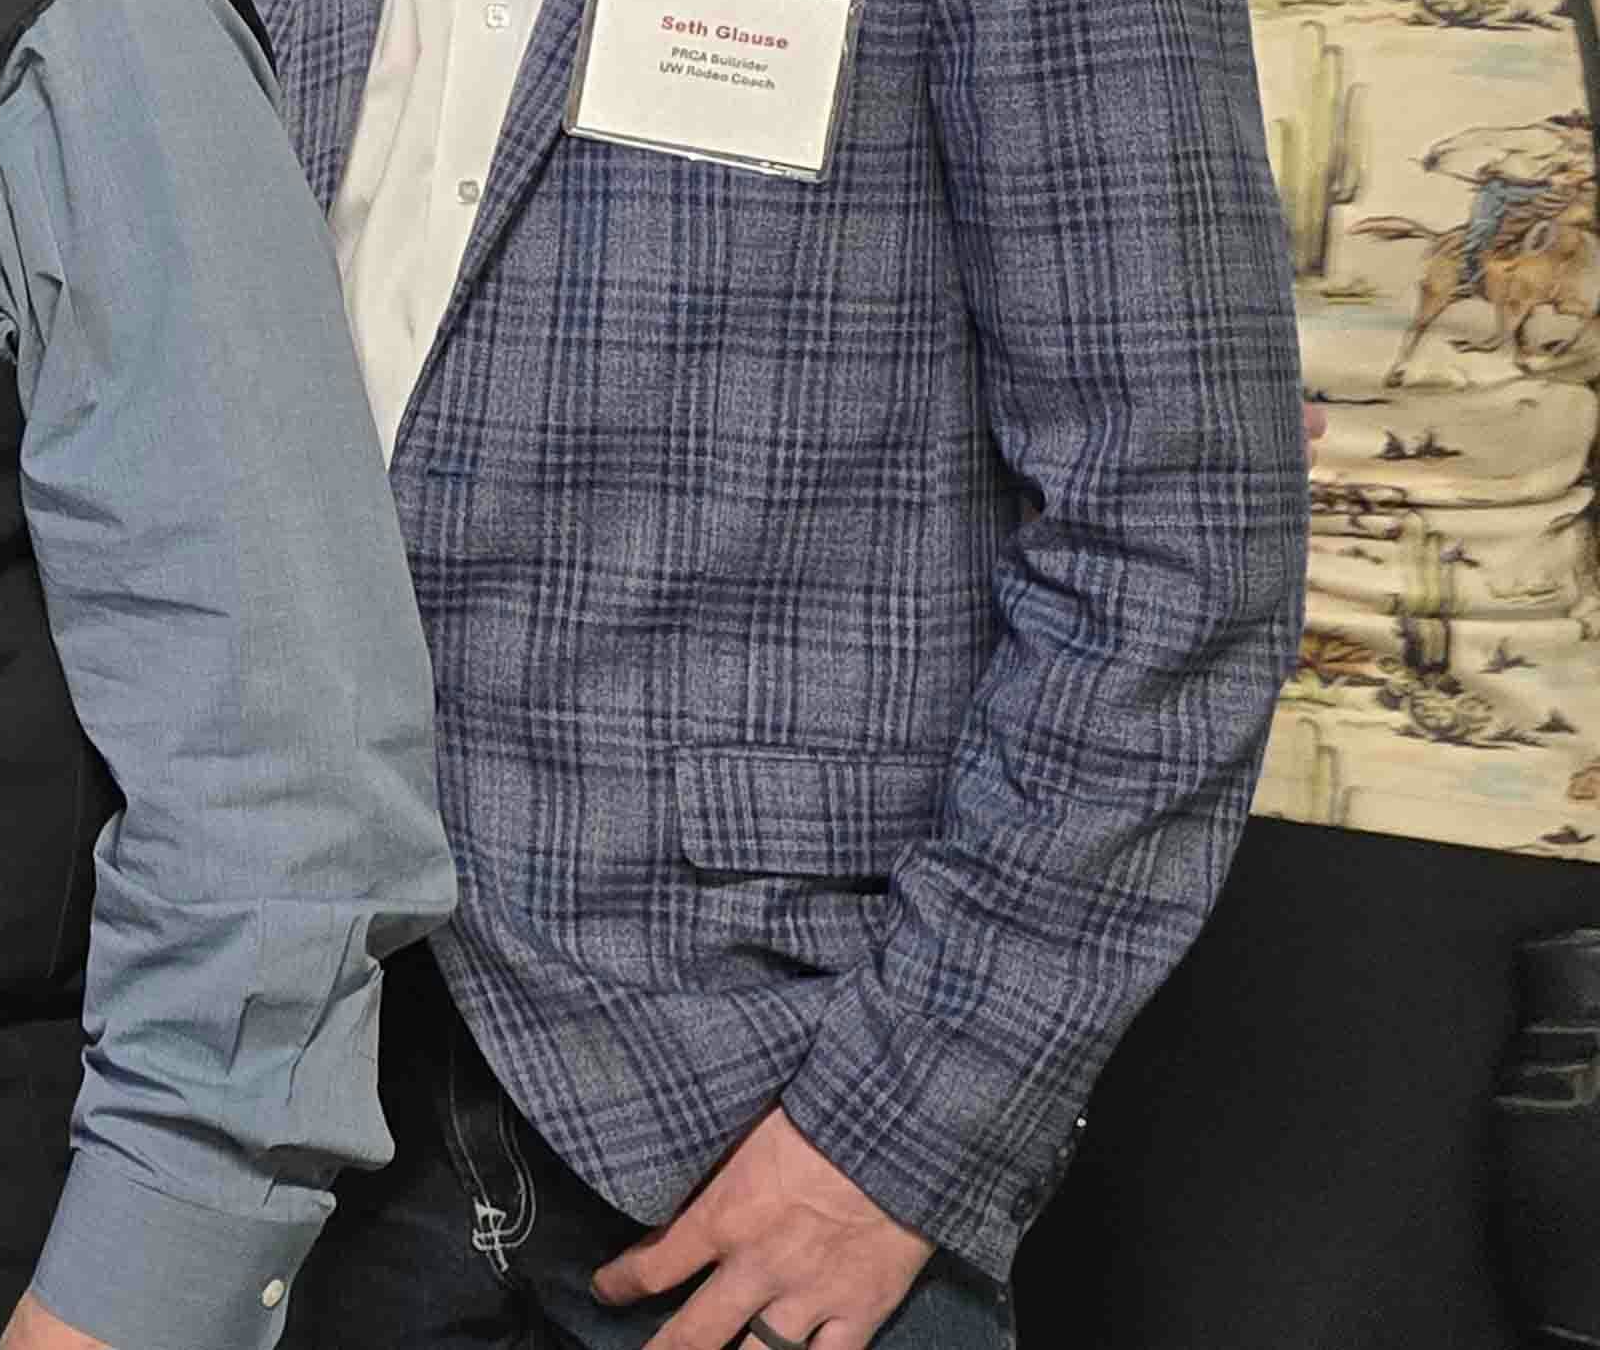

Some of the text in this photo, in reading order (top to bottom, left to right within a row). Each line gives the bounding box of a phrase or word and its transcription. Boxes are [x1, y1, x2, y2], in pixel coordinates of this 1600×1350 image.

[661, 15, 790, 49] Seth Glause
[671, 47, 769, 71] PRCA Bullrider
[659, 63, 776, 90] UW Rodeo Coach
